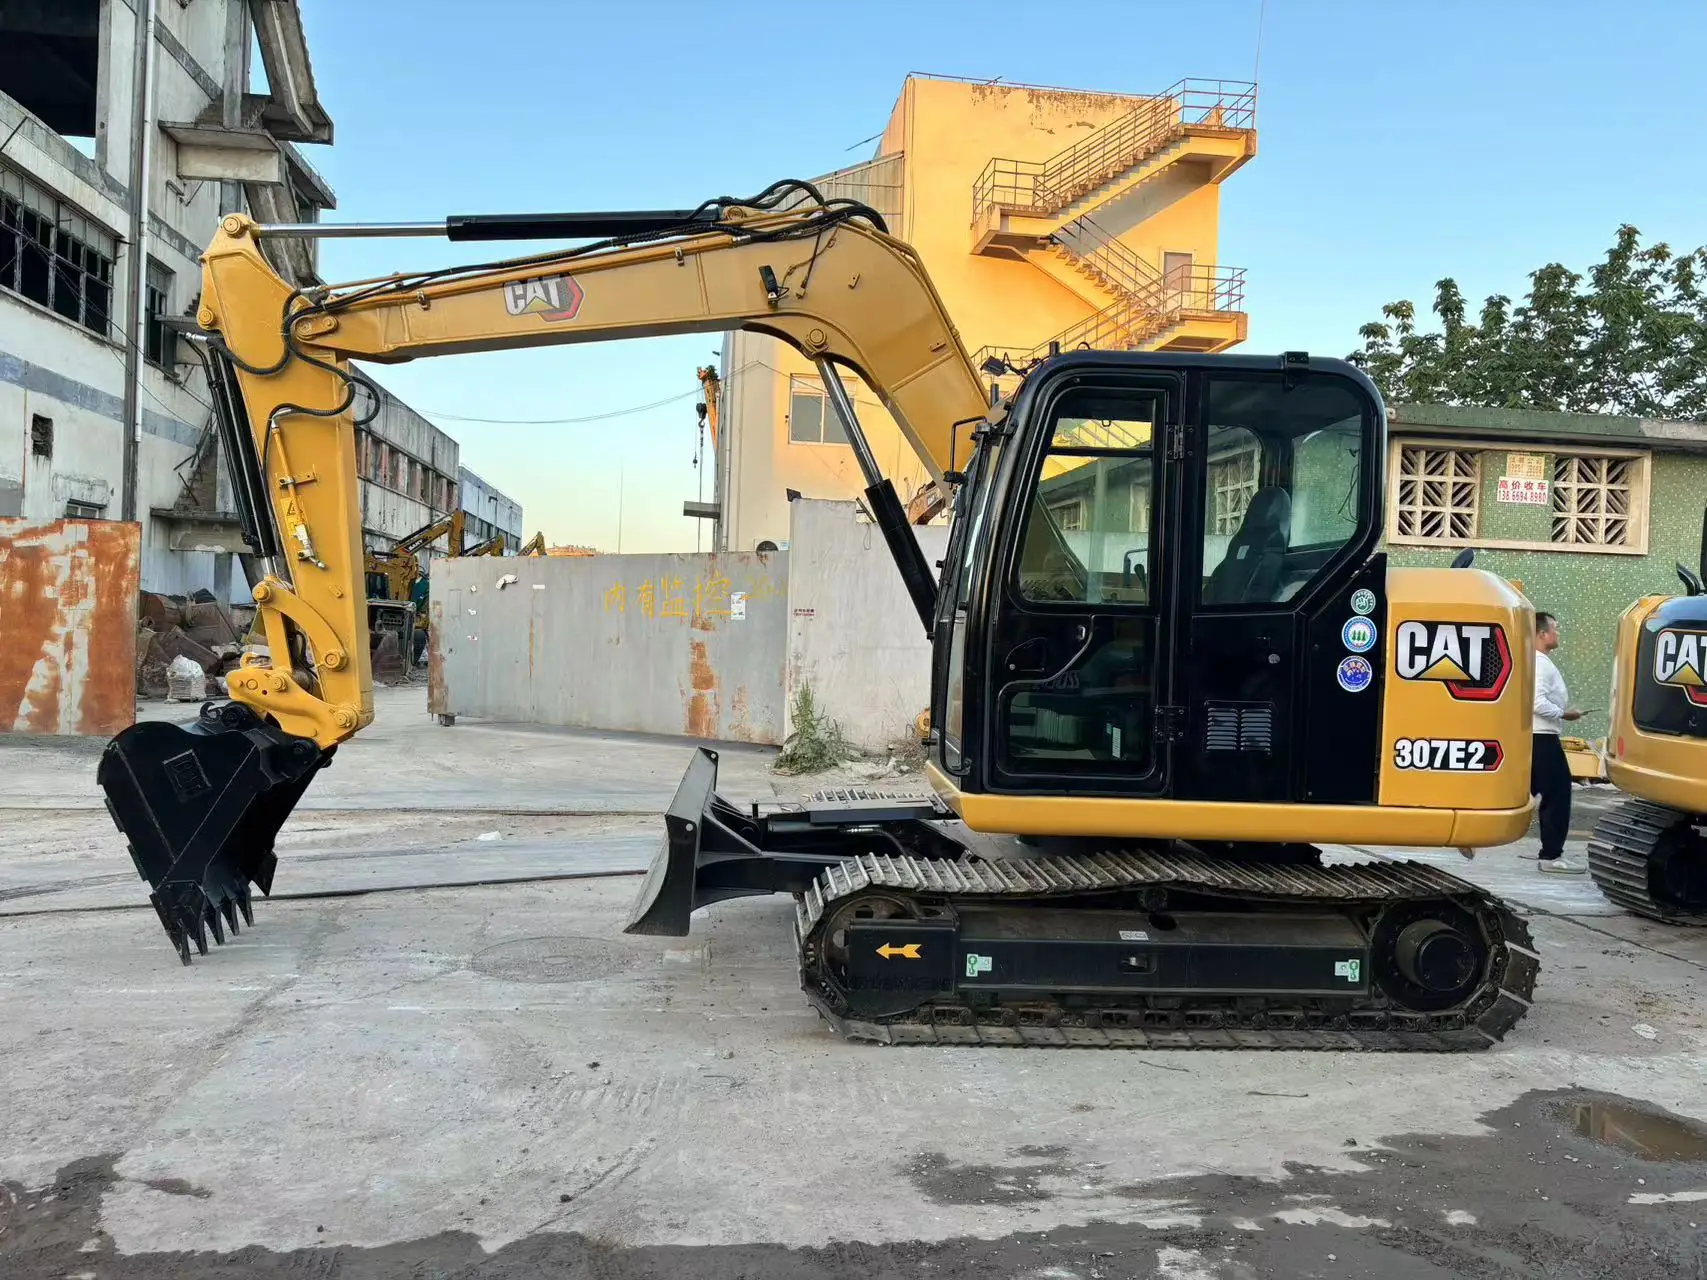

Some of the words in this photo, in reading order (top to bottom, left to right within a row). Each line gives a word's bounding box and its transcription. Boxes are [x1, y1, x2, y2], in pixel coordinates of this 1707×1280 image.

[503, 277, 561, 315] CAT
[1499, 480, 1547, 491] 高价收车
[604, 569, 734, 619] 内有监控
[1397, 621, 1491, 681] CAT
[1395, 738, 1487, 770] 307E2
